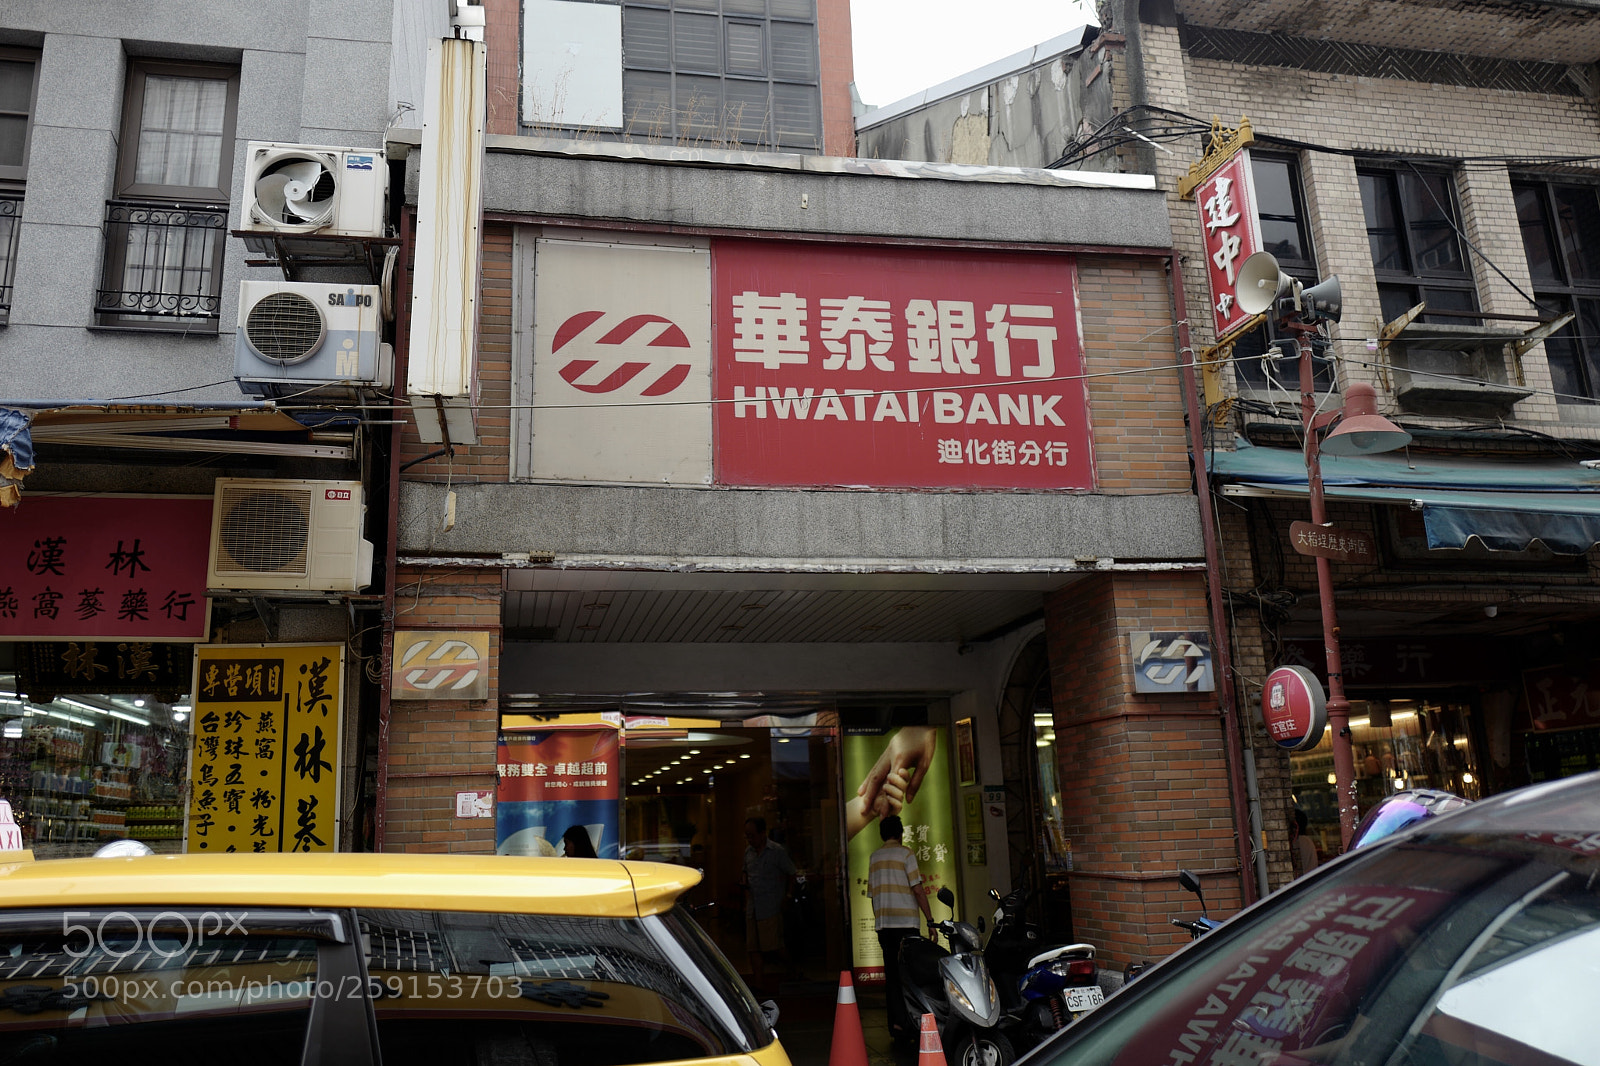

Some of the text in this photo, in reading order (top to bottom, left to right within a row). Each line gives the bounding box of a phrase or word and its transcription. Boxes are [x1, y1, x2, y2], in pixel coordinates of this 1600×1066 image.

[1204, 177, 1242, 287] 建中
[732, 291, 1058, 378] 華泰銀行
[733, 385, 1067, 427] HWATAI BANK
[937, 438, 1069, 467] 迪化街分行
[1297, 529, 1369, 555] 大稻埕歷史街區
[27, 536, 151, 578] 漢林
[1271, 718, 1298, 735] 正官庄
[496, 761, 608, 777] 服務雙全 卓越超前
[916, 843, 949, 863] 信貸
